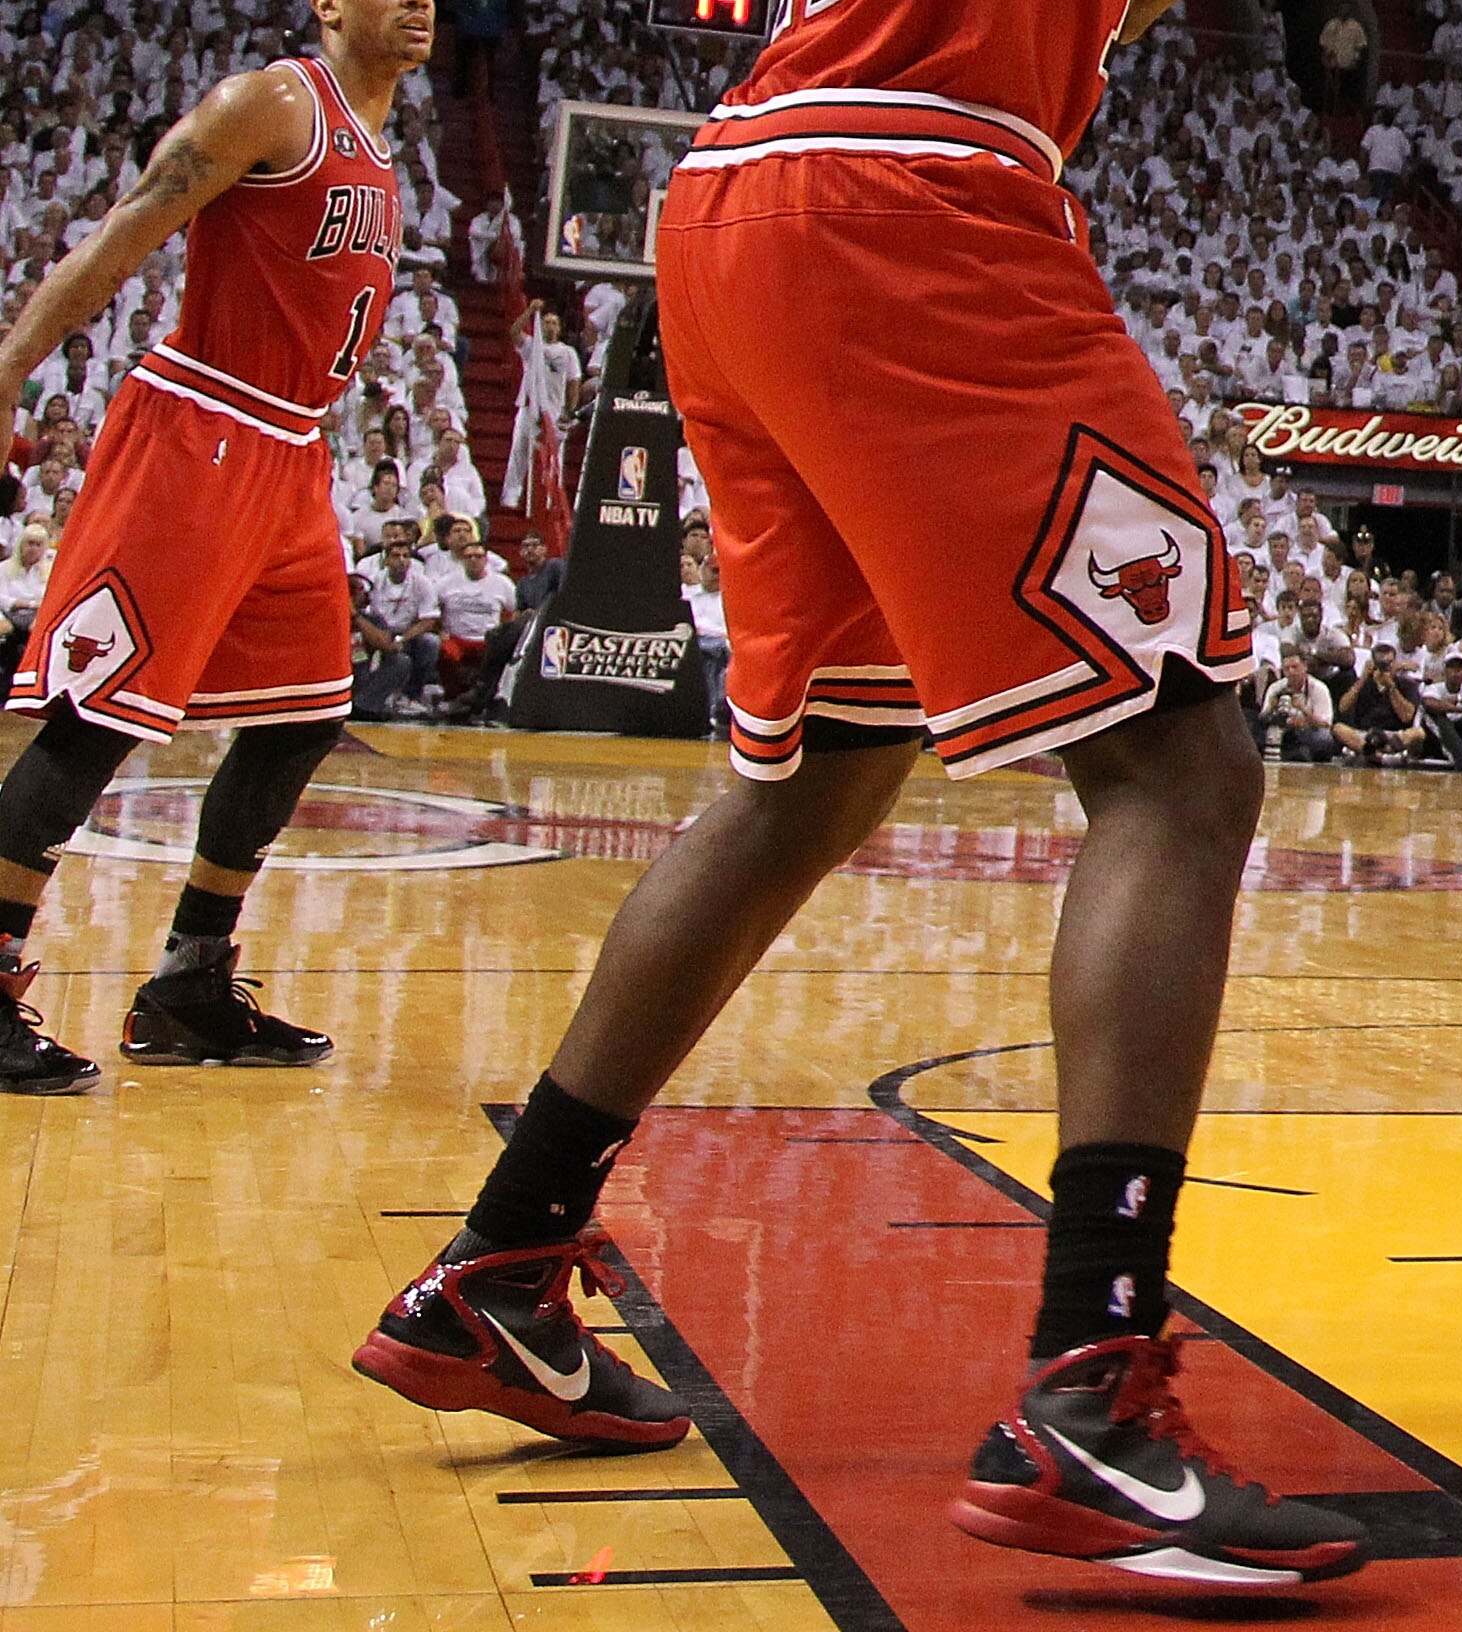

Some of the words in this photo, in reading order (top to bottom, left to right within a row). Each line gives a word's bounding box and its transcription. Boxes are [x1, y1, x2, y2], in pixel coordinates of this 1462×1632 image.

[328, 284, 376, 382] 1
[600, 504, 635, 526] NBA
[636, 506, 660, 528] TV
[569, 632, 687, 659] EASTERN
[568, 652, 681, 670] CONFERENCE
[581, 663, 659, 679] FINALS
